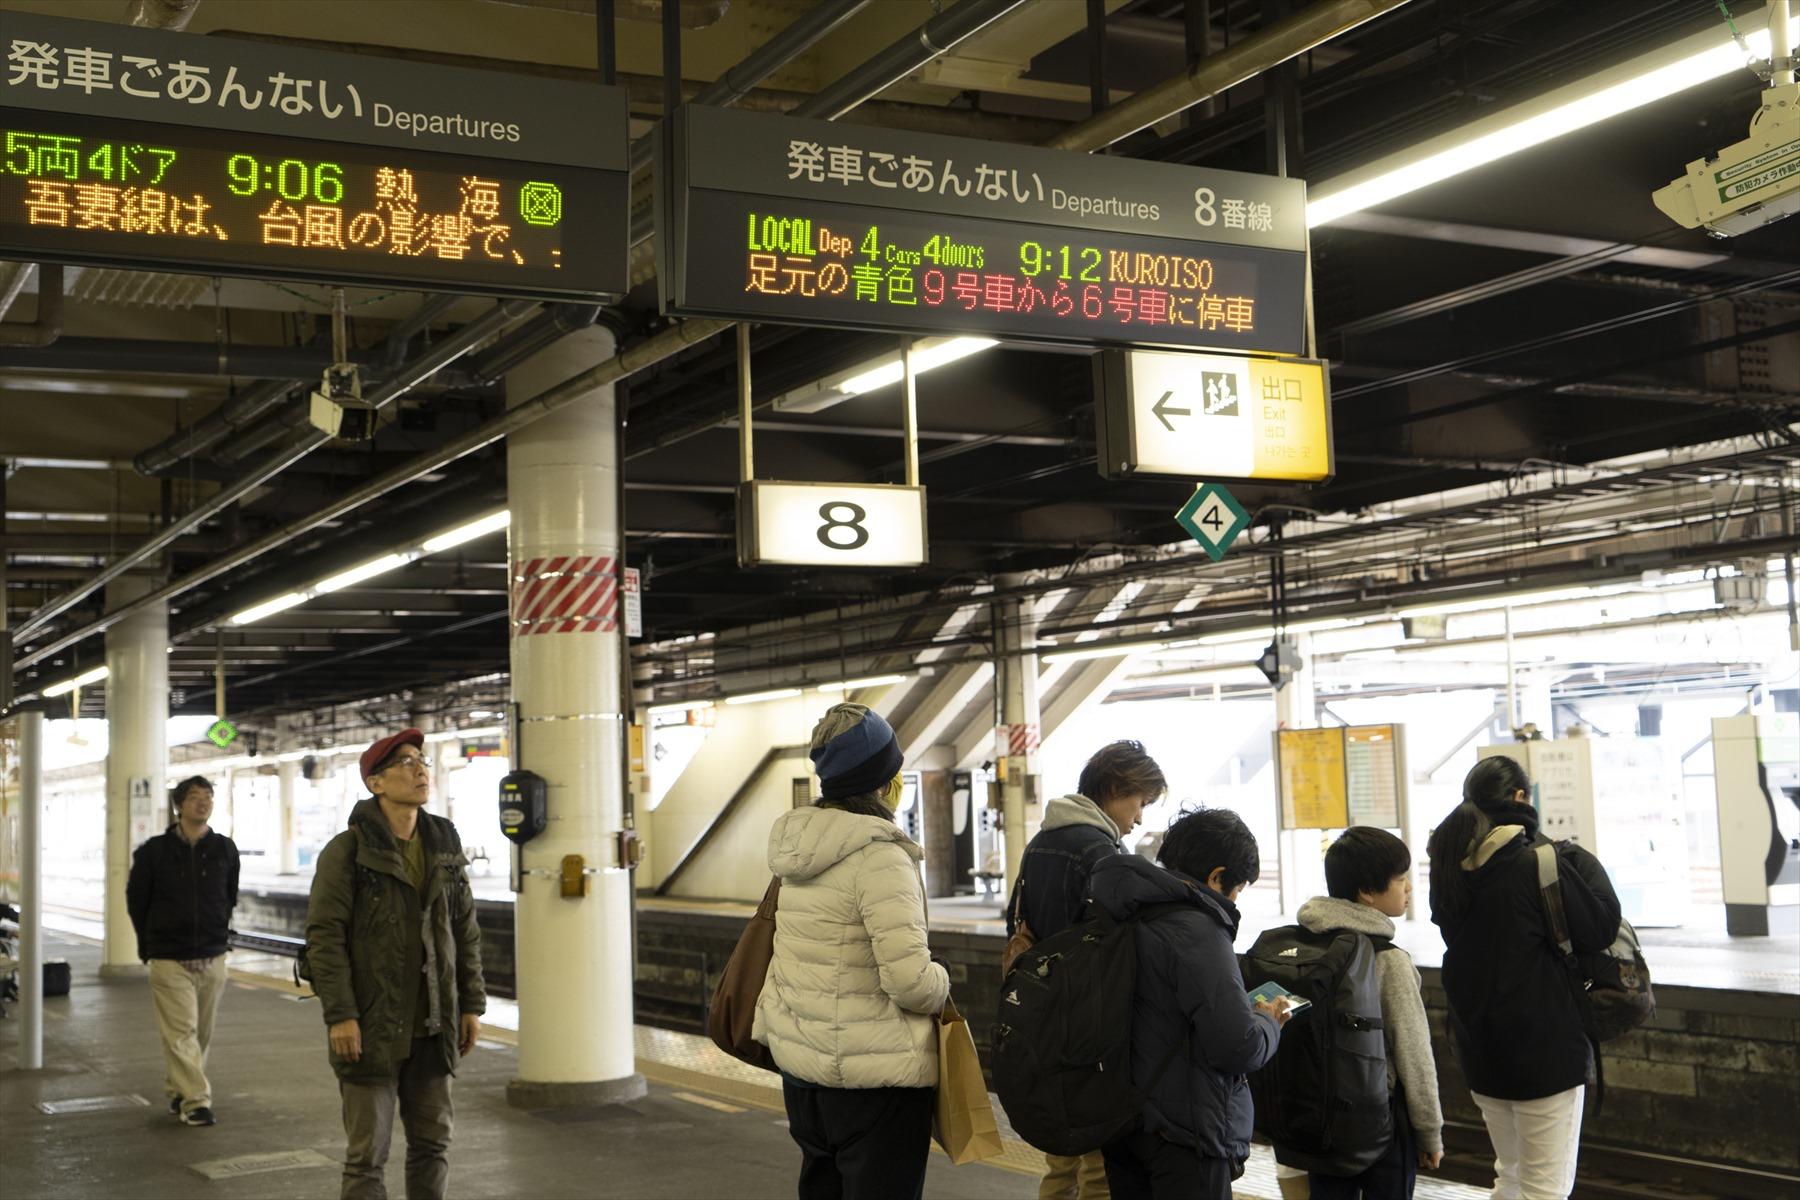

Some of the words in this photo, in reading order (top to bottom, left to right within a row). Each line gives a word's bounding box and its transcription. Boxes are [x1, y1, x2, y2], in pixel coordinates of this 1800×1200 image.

[7, 39, 362, 119] 発車ごあんない
[374, 103, 520, 142] Departures
[0, 131, 176, 184] 5両4ドア
[228, 154, 343, 203] 9:06
[787, 139, 1044, 204] 発車ごあんない
[1051, 188, 1160, 220] Departures
[24, 179, 561, 269] 吾妻線は、台風の影響で、
[748, 214, 816, 256] LOCAL
[819, 227, 854, 258] Dep.
[860, 226, 881, 262] 4
[885, 244, 921, 266] Cars
[1019, 241, 1102, 282] 9:12
[1108, 250, 1213, 290] KUROISO
[1262, 375, 1303, 402] 出口
[1263, 406, 1287, 421] Exit
[816, 500, 869, 549] 8
[1201, 504, 1224, 532] 4
